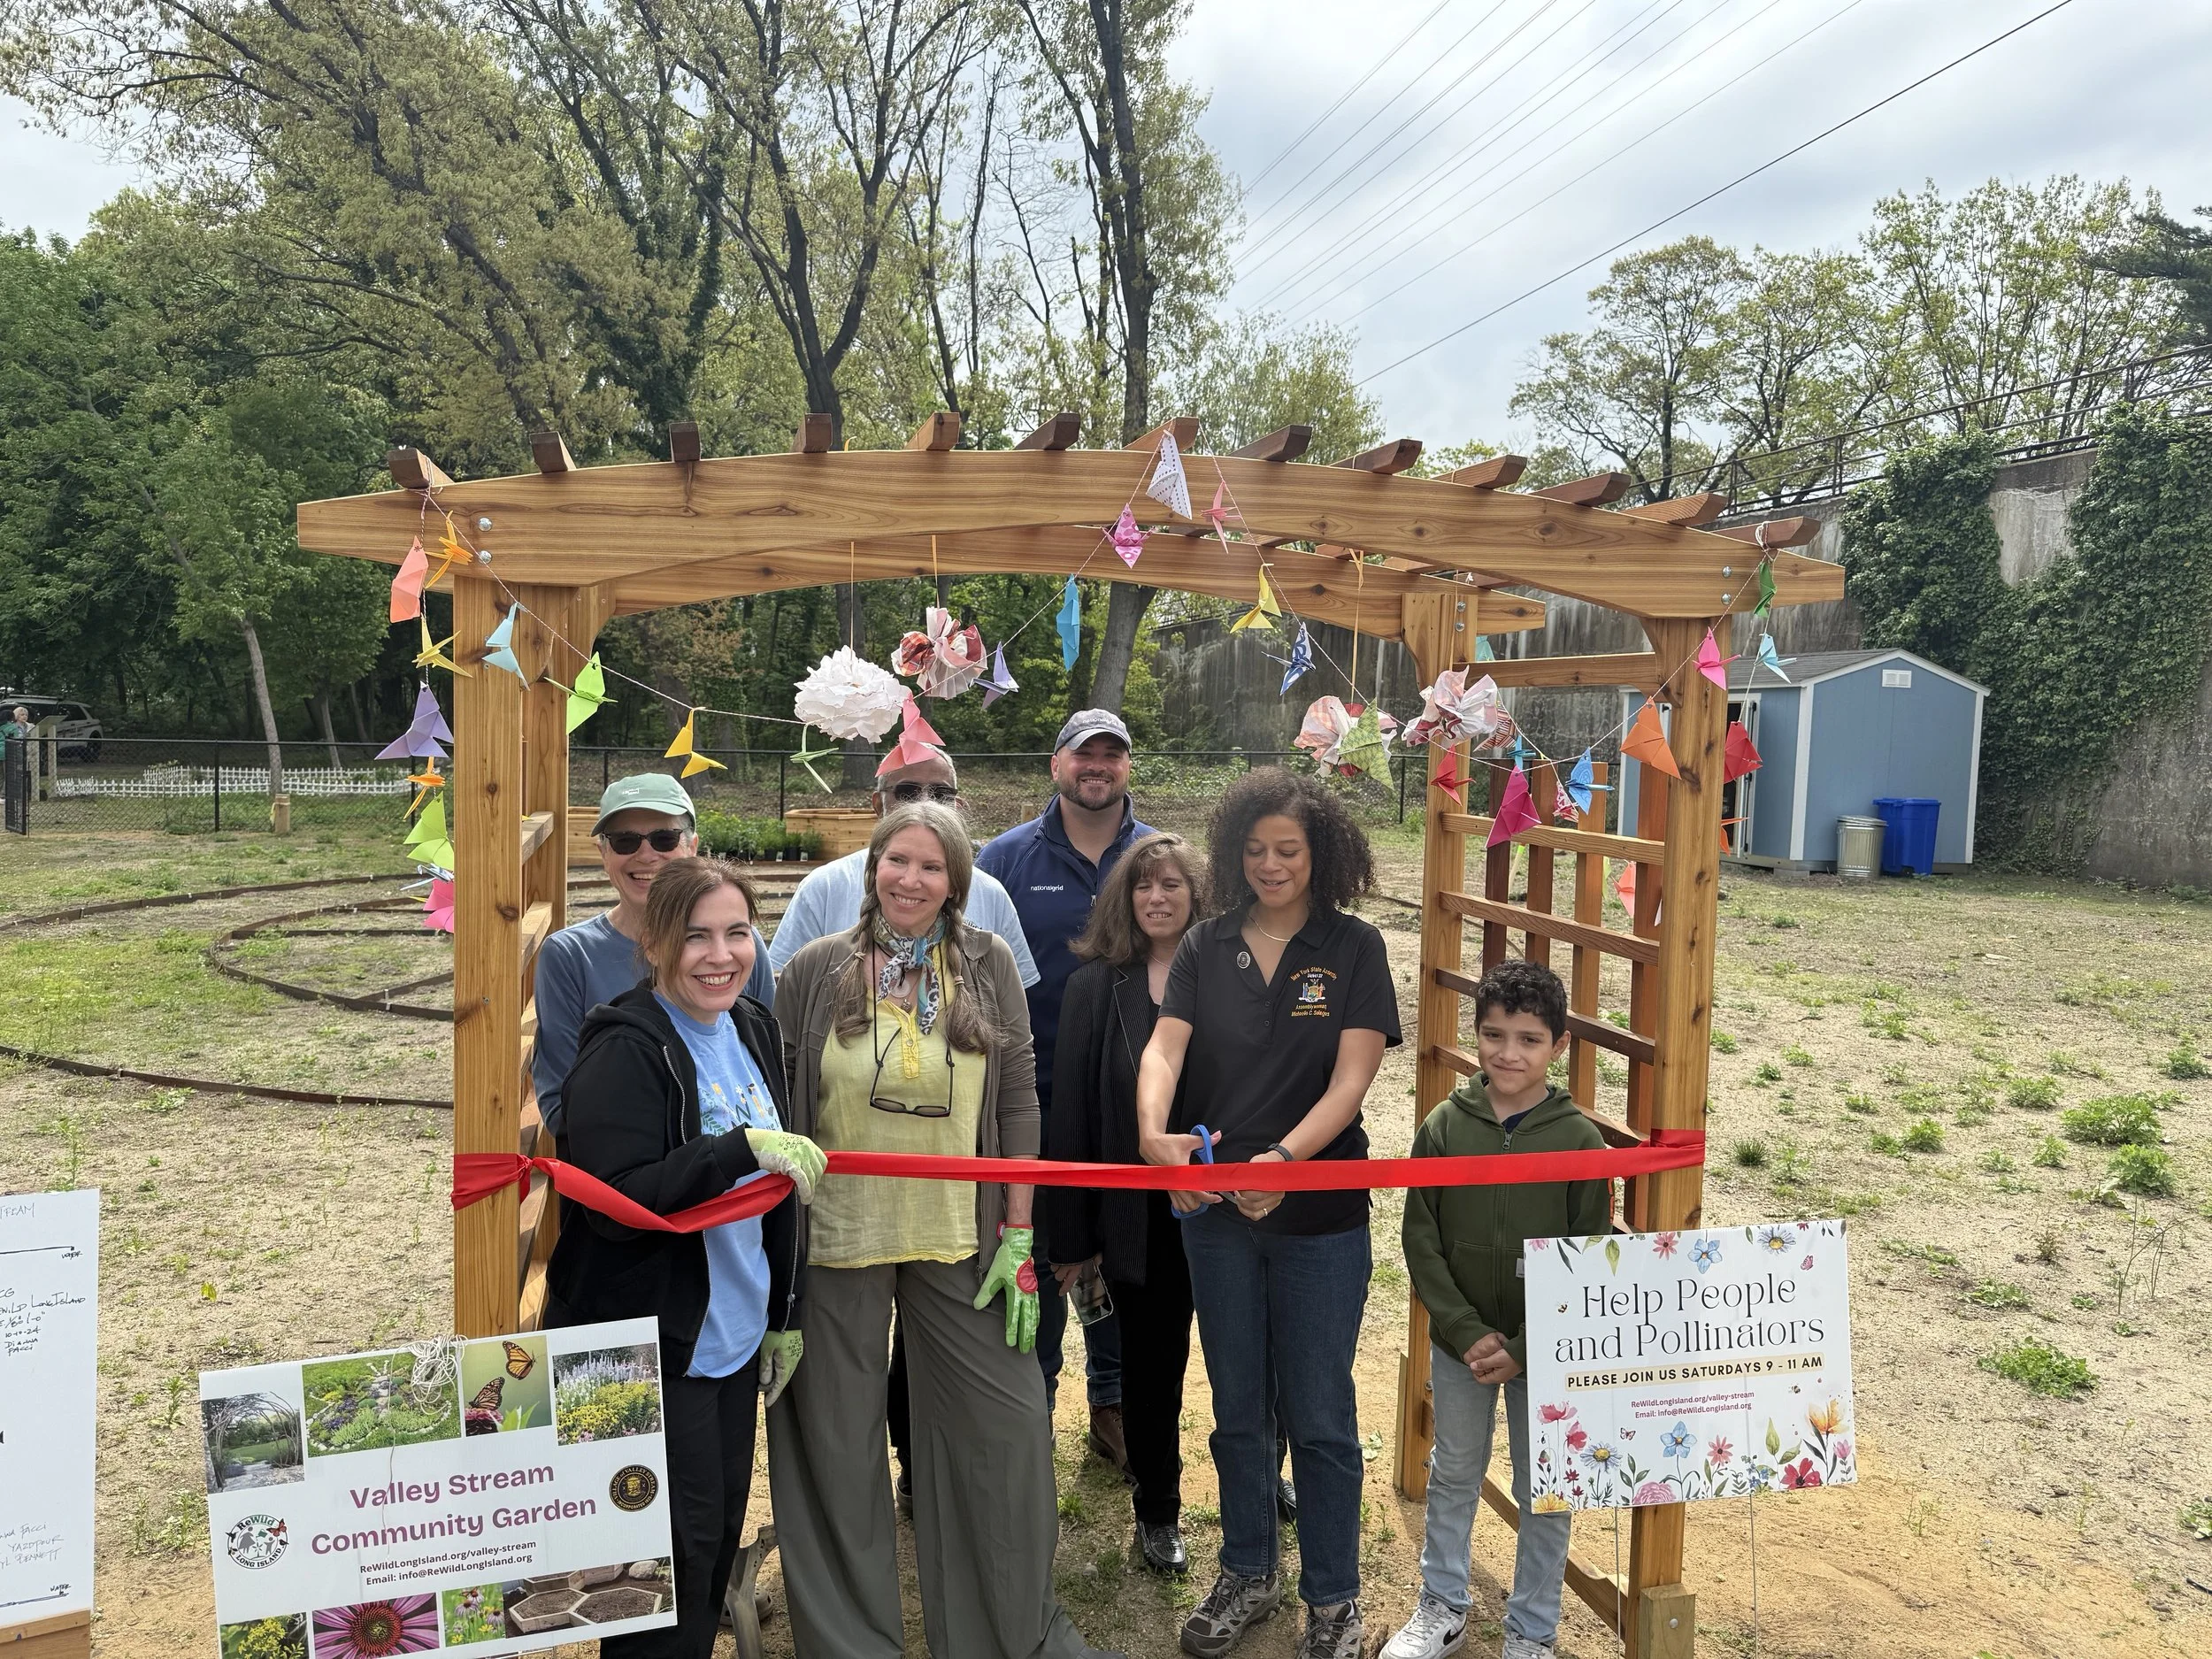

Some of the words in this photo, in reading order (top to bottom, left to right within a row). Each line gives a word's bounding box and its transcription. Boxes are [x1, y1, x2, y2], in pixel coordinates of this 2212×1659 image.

[1030, 884, 1064, 893] nationalgrid
[1582, 1283, 1663, 1325] Help
[1677, 1273, 1796, 1318] People
[1555, 1326, 1623, 1363] and
[1636, 1317, 1825, 1357] Pollinators
[1567, 1373, 1618, 1388] PLEASE
[1623, 1370, 1655, 1384] JOIN
[1658, 1369, 1678, 1381] US
[1681, 1361, 1762, 1379] SATURDAYS
[1765, 1360, 1774, 1372] 9
[1787, 1358, 1798, 1371] 11
[1801, 1356, 1823, 1370] AM
[1631, 1391, 1755, 1409] ReWildLongIsland.org/valley-stream
[1657, 1402, 1752, 1417] info@ReWildLongIsland.org
[349, 1481, 440, 1509] Valley
[449, 1465, 555, 1495] Stream
[236, 1516, 275, 1531] ReWild
[311, 1513, 485, 1555] Community
[492, 1498, 597, 1529] Garden
[235, 1555, 256, 1568] LONG
[257, 1548, 282, 1568] ISLAND
[359, 1540, 537, 1574] ReWildLongIsland.org/valley-stream
[365, 1573, 397, 1586] Email:
[398, 1553, 533, 1582] info@ReWildLongIsland.org
